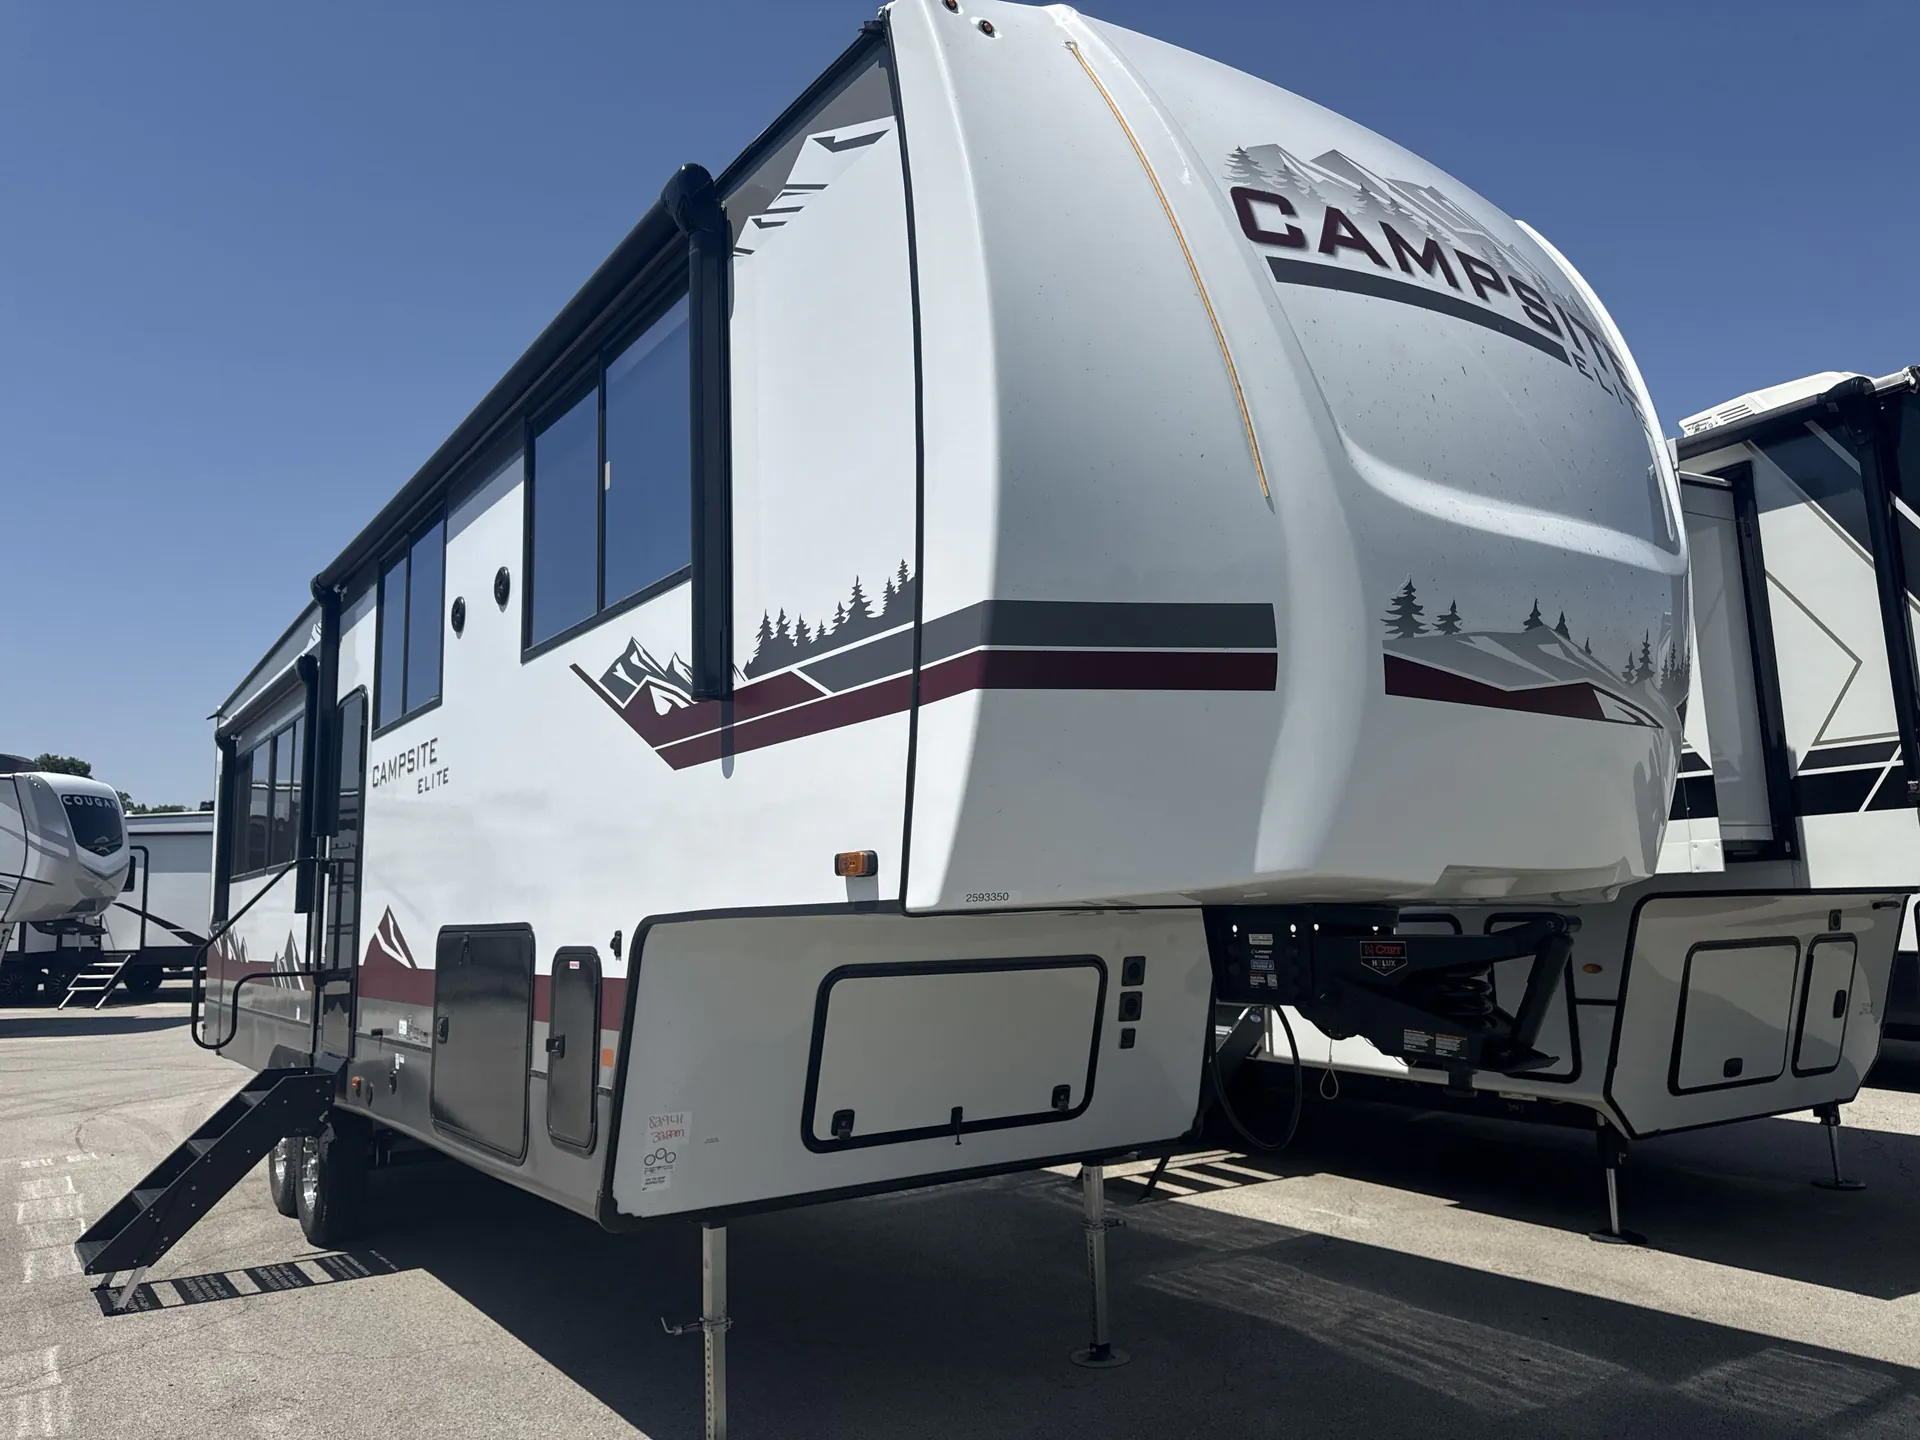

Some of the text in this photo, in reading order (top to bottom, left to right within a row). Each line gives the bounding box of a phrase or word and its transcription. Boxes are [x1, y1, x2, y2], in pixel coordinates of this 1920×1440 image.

[1230, 186, 1641, 407] CAMPSITE
[372, 737, 438, 788] CAMPSITE
[417, 766, 449, 794] ELITE
[62, 796, 117, 809] COUGAR
[966, 892, 1010, 902] 2593350
